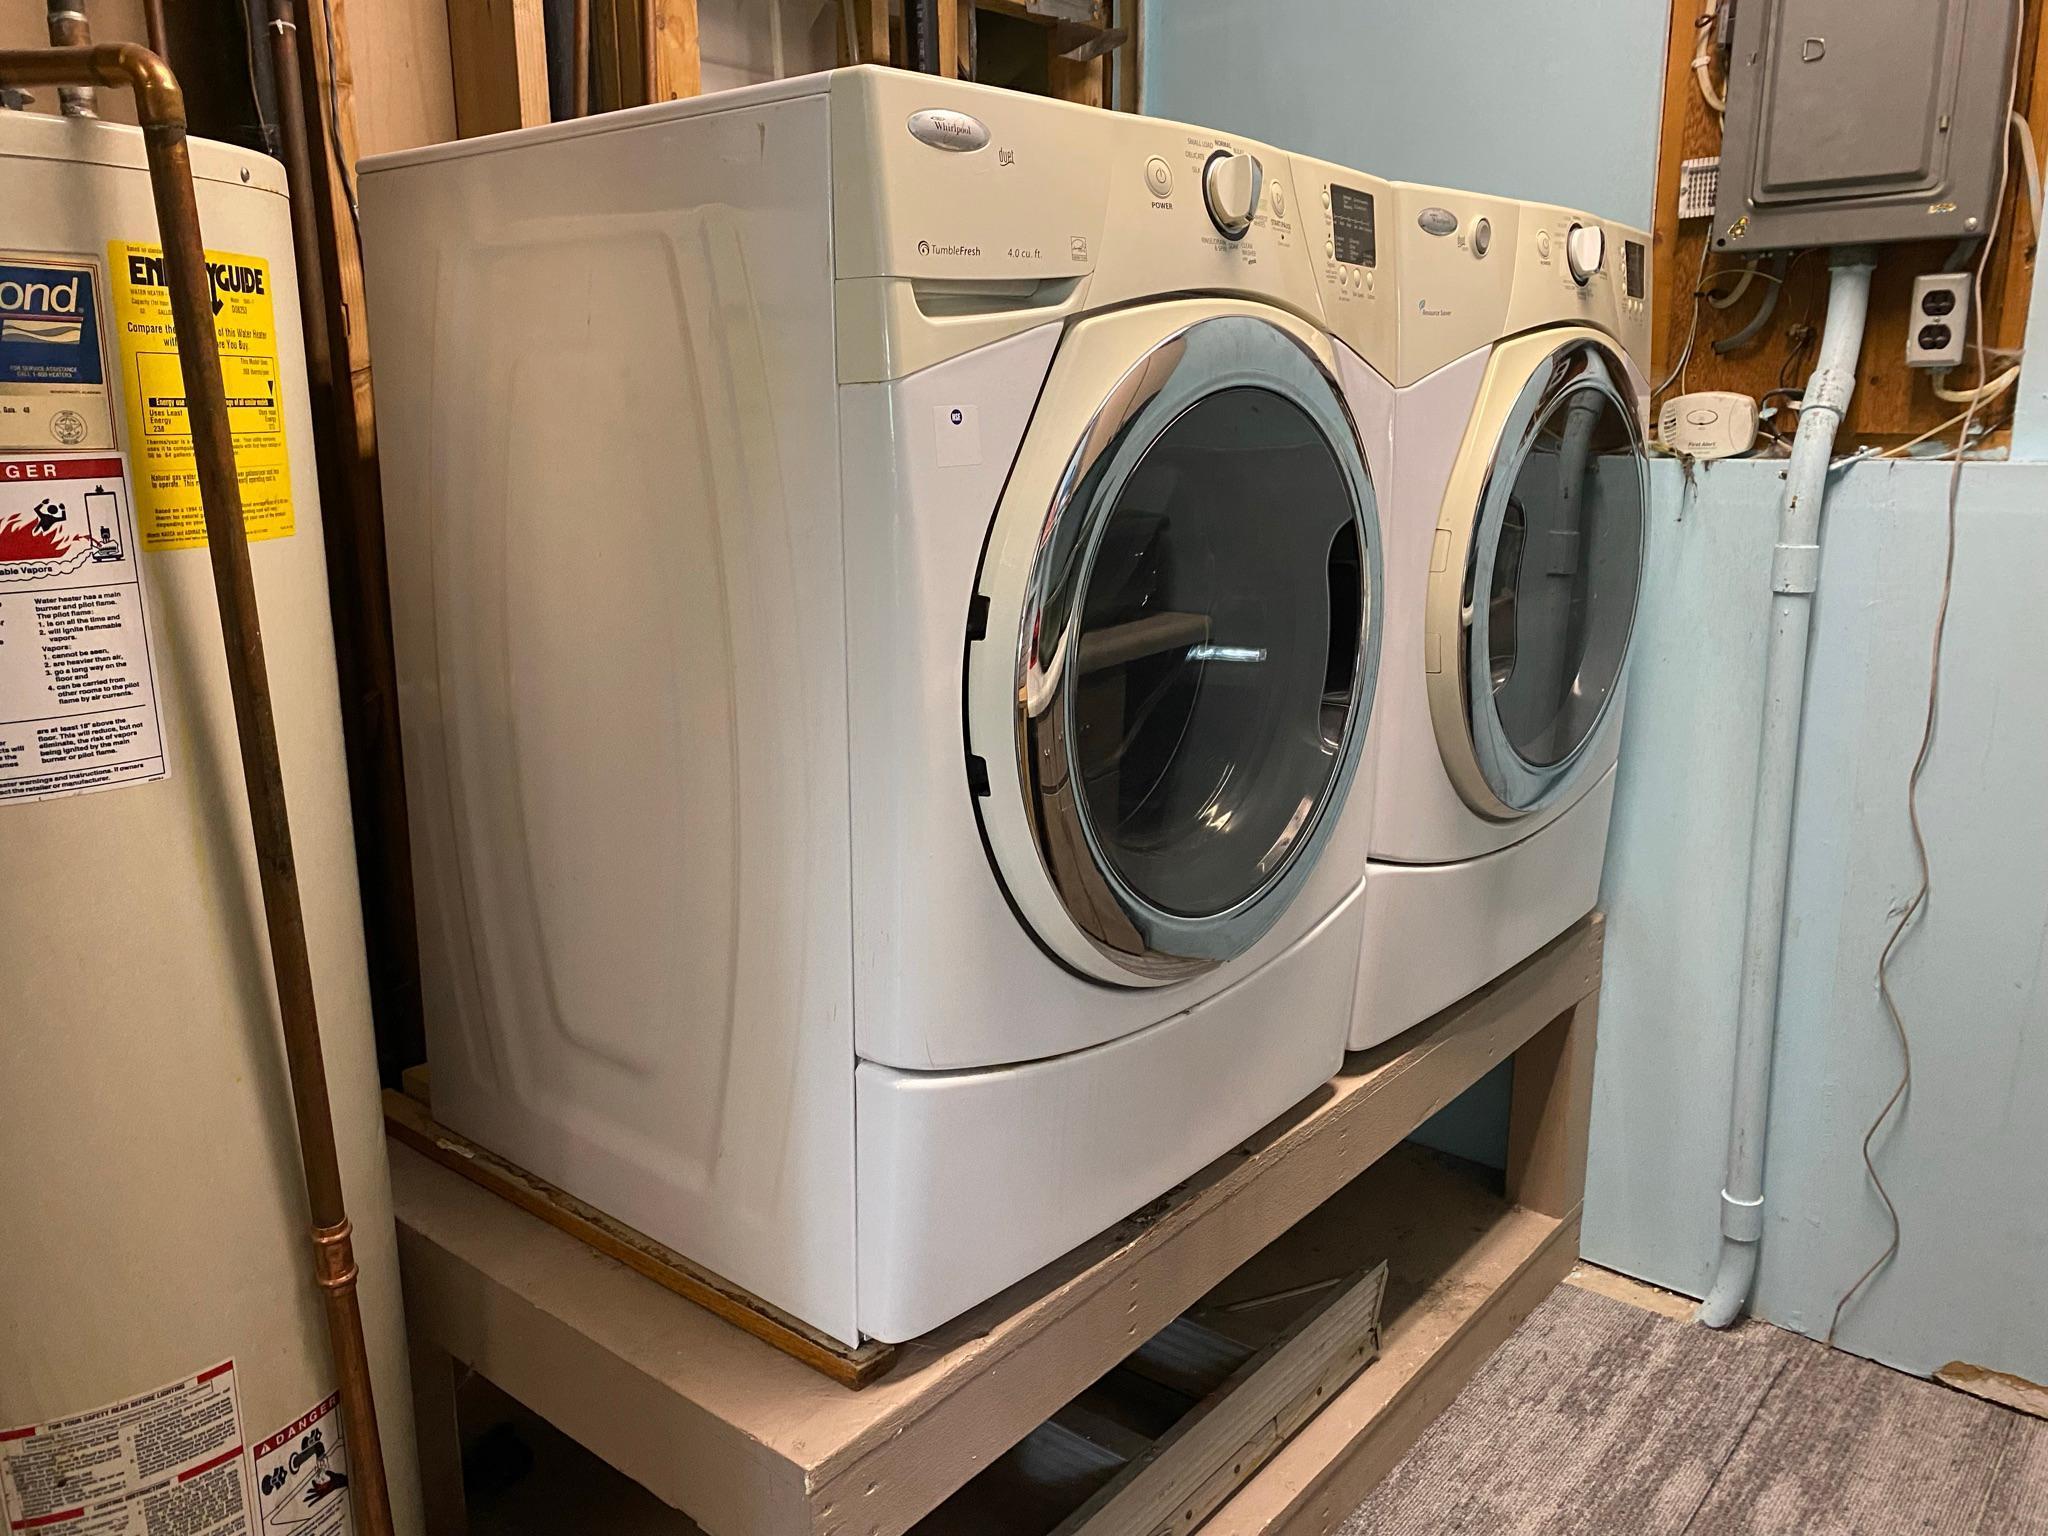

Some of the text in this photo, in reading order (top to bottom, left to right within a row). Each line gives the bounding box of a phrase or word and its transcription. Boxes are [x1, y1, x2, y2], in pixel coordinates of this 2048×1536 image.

[934, 121, 972, 135] Whirlpool
[1152, 202, 1173, 210] POWER
[931, 245, 981, 256] TumbleFresh
[1008, 248, 1043, 259] 4.0 cu. ft.
[128, 322, 162, 335] Compare
[225, 328, 236, 337] this
[237, 328, 252, 338] Water
[226, 340, 237, 349] You
[150, 417, 171, 425] Energy
[6, 464, 57, 478] GER
[20, 566, 53, 574] Vapors
[63, 626, 84, 634] ignite
[85, 622, 122, 631] flammable
[42, 645, 72, 653] Vapors:
[52, 651, 78, 659] cannot
[66, 658, 94, 666] heavier
[82, 679, 108, 687] carried
[58, 690, 77, 698] other
[124, 682, 140, 690] pilot
[92, 720, 114, 728] above
[114, 731, 138, 739] vapors
[63, 745, 89, 754] ignited
[42, 756, 67, 764] burner
[78, 752, 95, 760] pilot
[96, 748, 118, 756] flame.
[19, 778, 53, 786] warnings
[69, 768, 113, 779] instructions.
[26, 784, 52, 792] retailer
[62, 776, 111, 787] manufacturer.
[48, 1423, 62, 1431] FOR
[84, 1410, 109, 1422] SAFETY
[111, 1404, 129, 1414] READ
[130, 1395, 155, 1408] BEFORE
[156, 1384, 185, 1399] LIGHTING
[276, 1396, 336, 1445] DANGER
